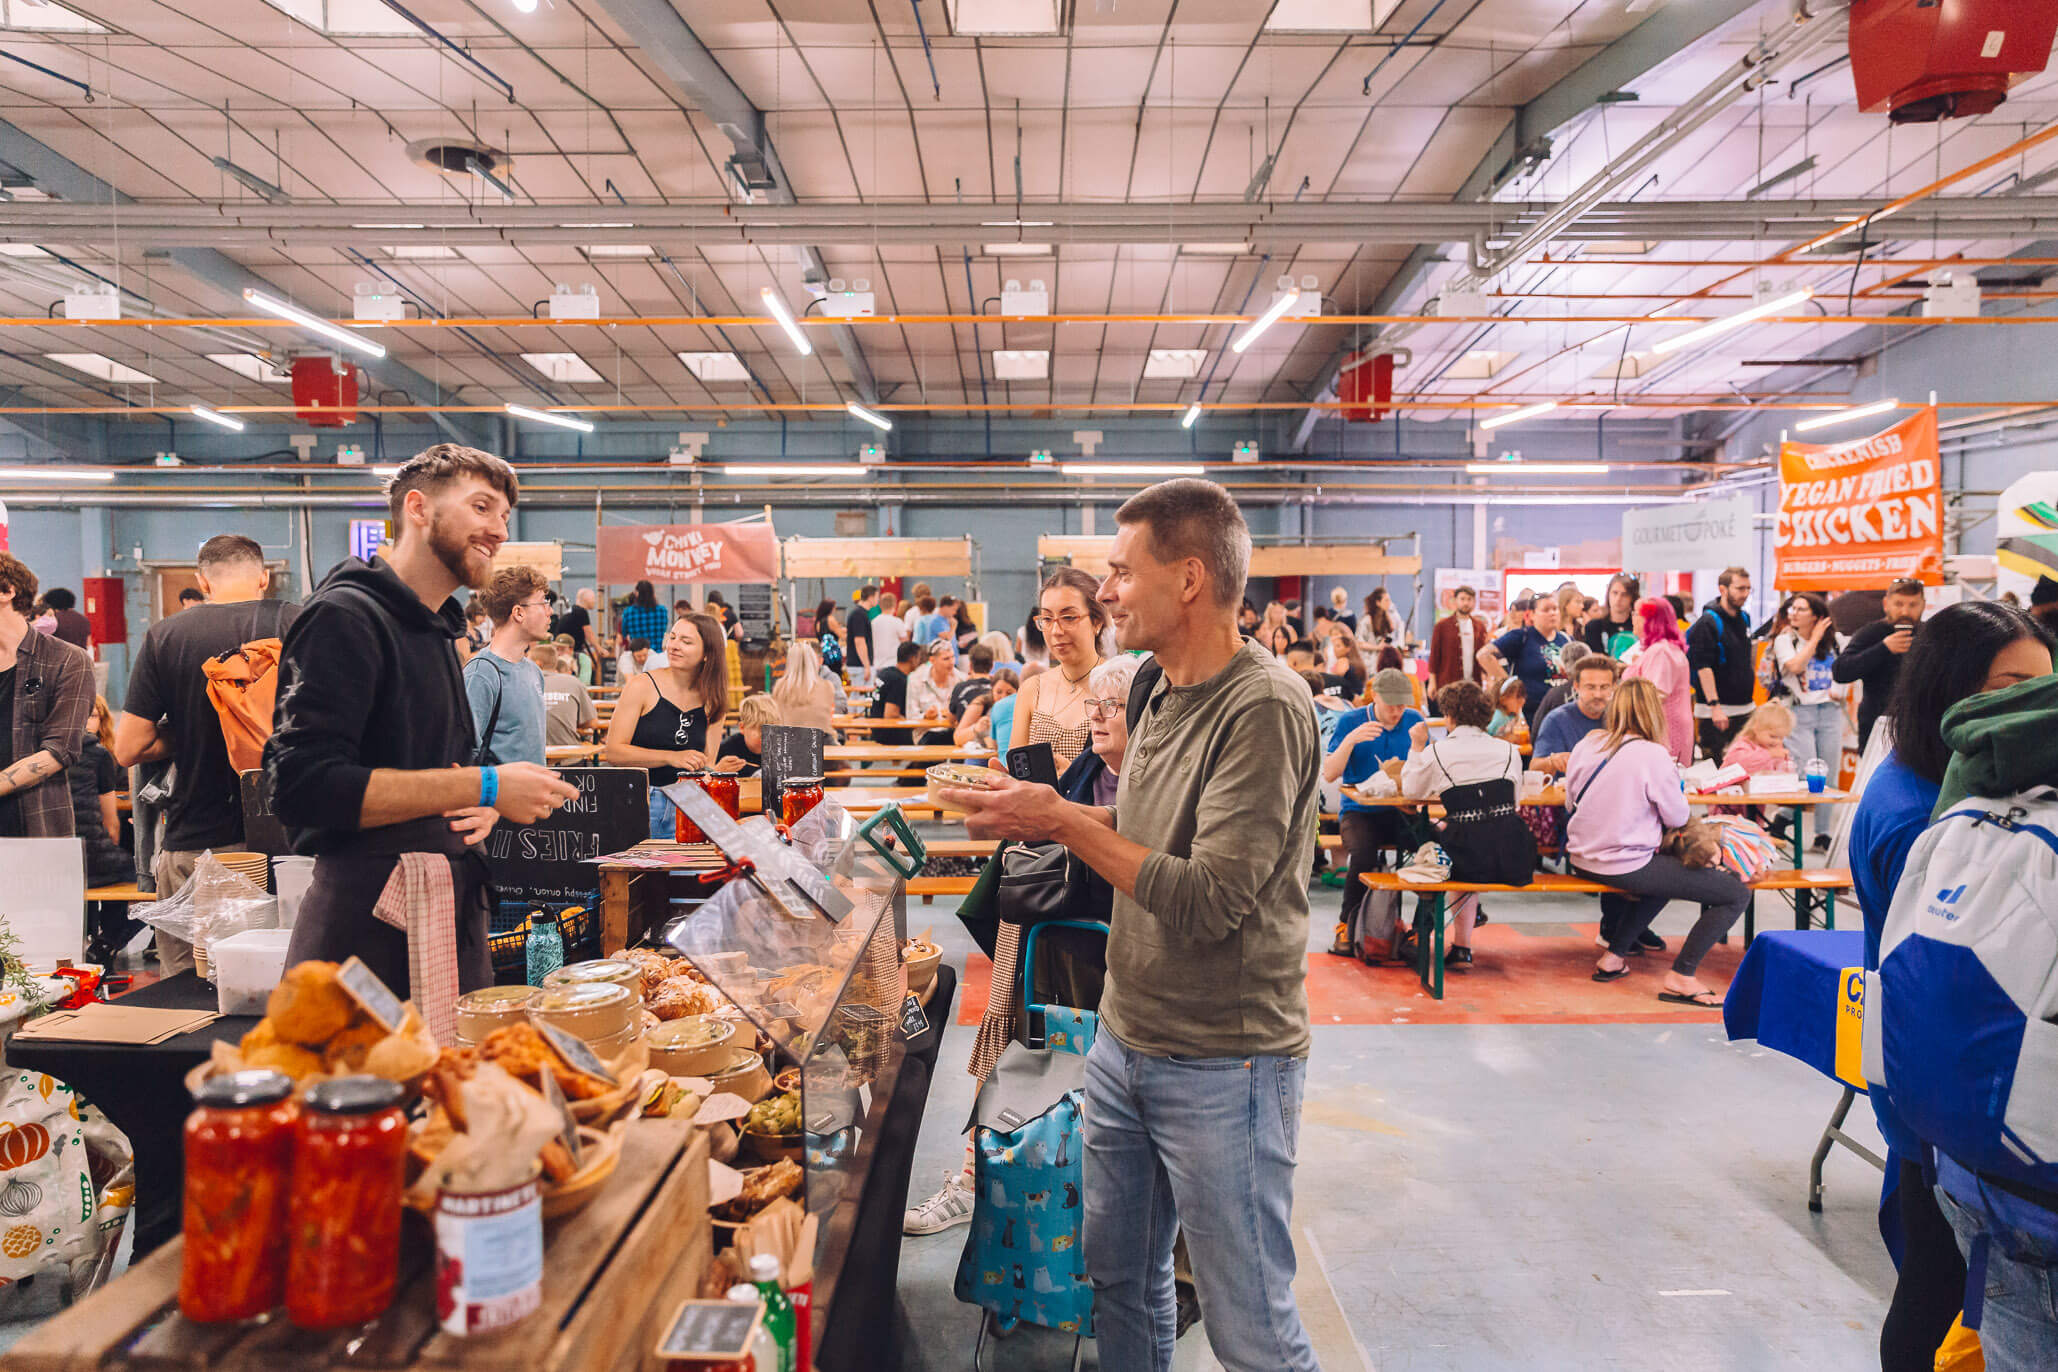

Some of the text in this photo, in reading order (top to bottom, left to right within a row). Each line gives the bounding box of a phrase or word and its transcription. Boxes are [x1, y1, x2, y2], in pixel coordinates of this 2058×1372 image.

[1780, 459, 1935, 508] VEGAN FRIED
[1774, 494, 1937, 548] CHICKEN
[647, 541, 723, 569] MONKEY
[562, 794, 598, 813] FIND
[518, 828, 600, 862] FRIES
